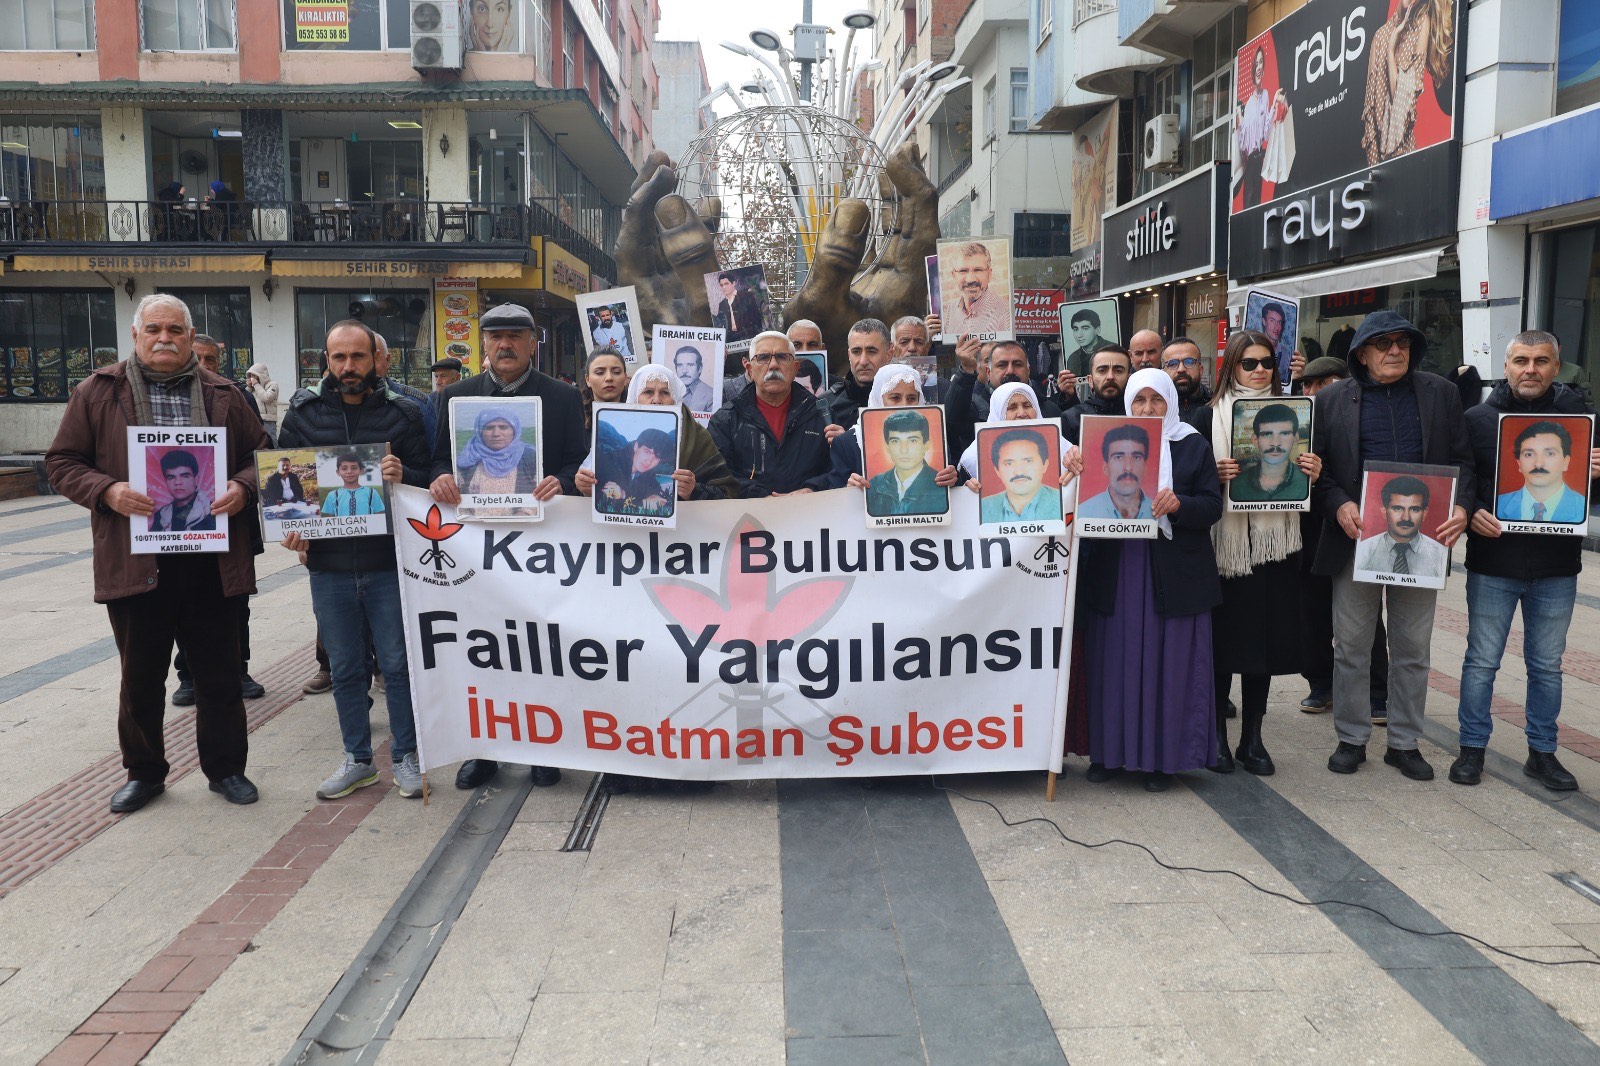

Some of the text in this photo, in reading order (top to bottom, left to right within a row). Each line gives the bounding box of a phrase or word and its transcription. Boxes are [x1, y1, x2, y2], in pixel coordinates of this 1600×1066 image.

[299, 30, 314, 39] 0532
[316, 30, 327, 39] 553
[330, 30, 337, 39] 58
[1294, 6, 1366, 91] rays
[1263, 181, 1366, 250] rays
[1126, 201, 1174, 261] stilife
[133, 257, 191, 268] SOFRASI
[391, 262, 449, 273] SOFRASI
[1189, 293, 1214, 316] stilife
[1014, 308, 1060, 318] llection
[659, 328, 722, 342] İBRAHİM ÇELİK
[980, 332, 997, 341] ELÇİ
[137, 431, 218, 446] EDİP ÇELİK
[472, 496, 523, 505] Taybet Ana
[281, 516, 367, 530] İBRAHİM ATILGAN
[604, 515, 664, 526] İSMAİL AĞAYA
[875, 516, 943, 526] M.ŞİRİN MALTU
[324, 526, 368, 537] ATILGAN
[999, 524, 1045, 535] İSA GÖK
[1084, 523, 1106, 533] Eset
[1507, 524, 1574, 534] İZZET SEVEN
[183, 533, 227, 541] GÖZALTINDA
[160, 544, 202, 552] KAYBEDİLDİ
[483, 528, 1012, 587] Kayıplar Bulunsun
[418, 610, 645, 682] Failler
[467, 686, 1024, 767] İHD Batman Şubesi
